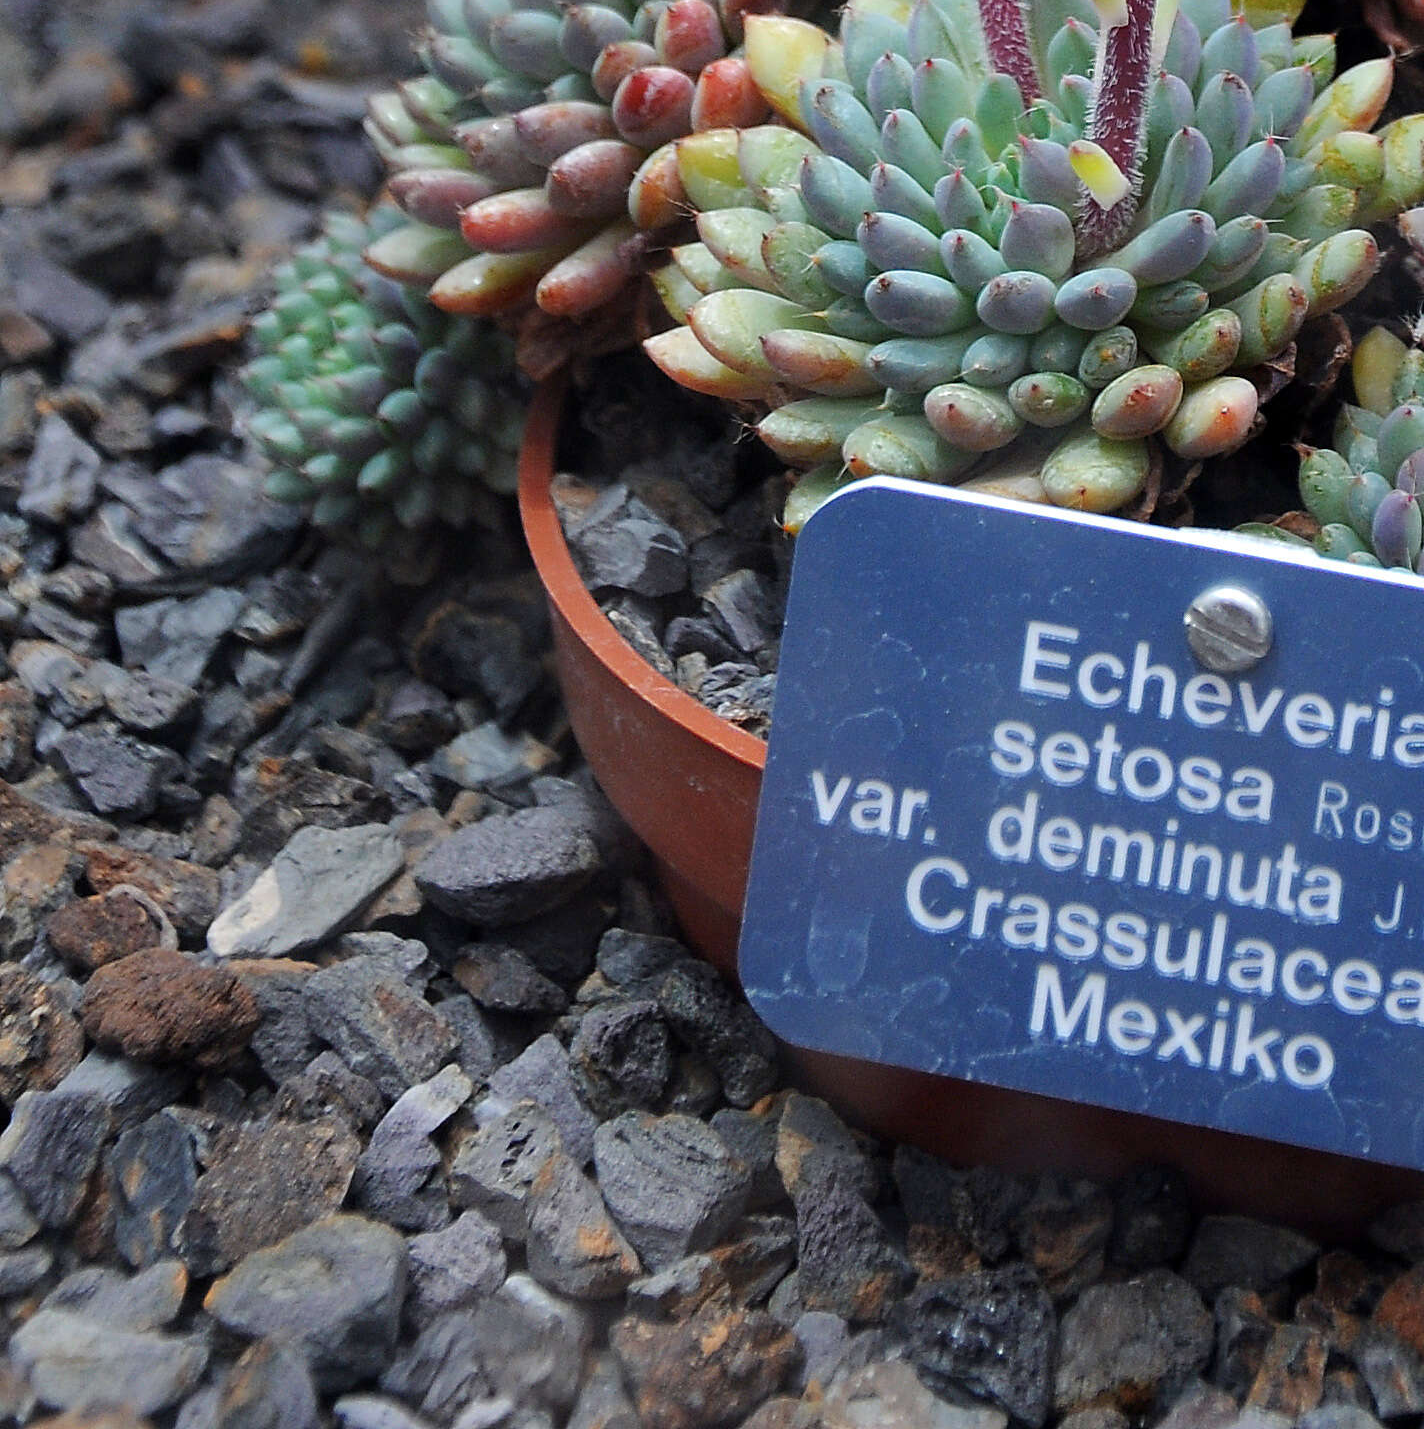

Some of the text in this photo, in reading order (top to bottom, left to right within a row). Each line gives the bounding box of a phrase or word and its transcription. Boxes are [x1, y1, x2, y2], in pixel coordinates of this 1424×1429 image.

[991, 721, 1274, 823] setosa
[811, 770, 937, 843] var.
[988, 793, 1342, 923] deminuta
[1030, 965, 1335, 1090] Mexiko
